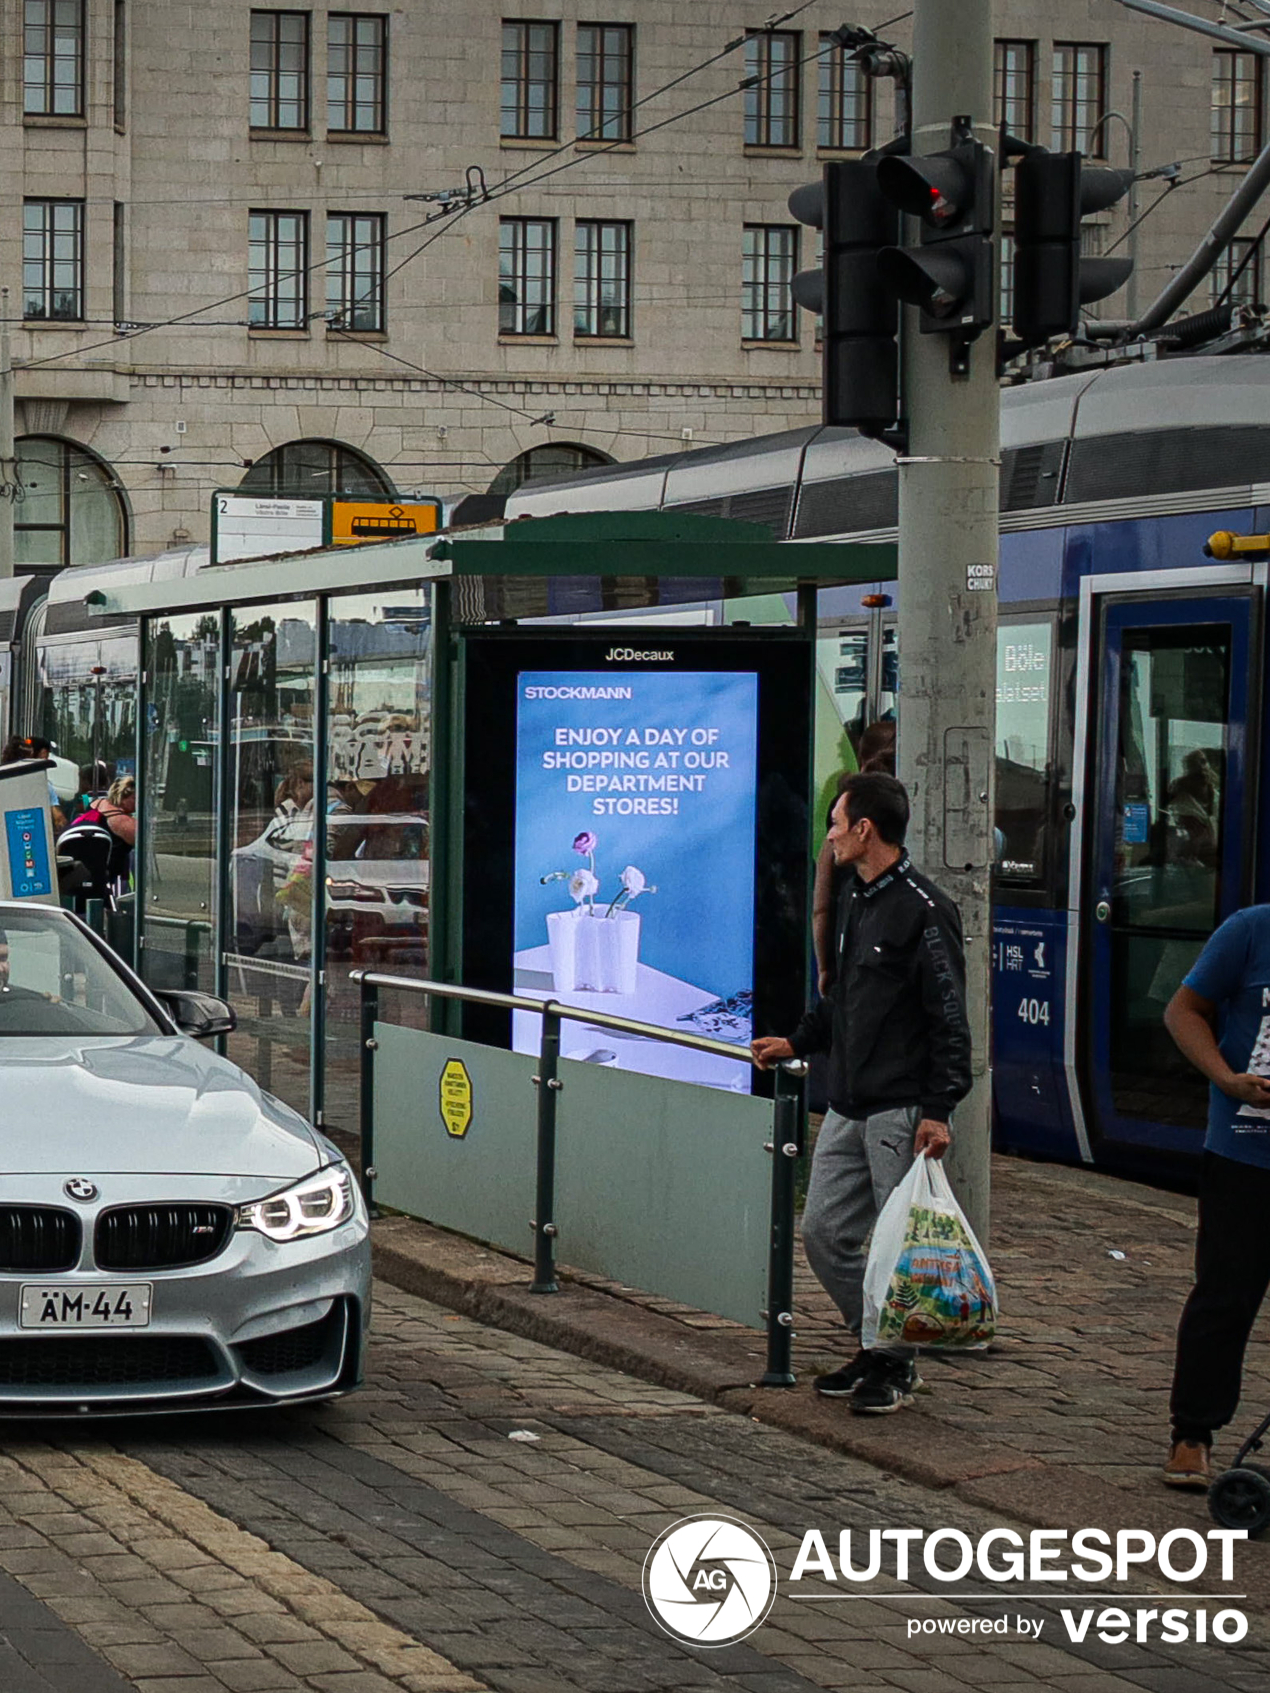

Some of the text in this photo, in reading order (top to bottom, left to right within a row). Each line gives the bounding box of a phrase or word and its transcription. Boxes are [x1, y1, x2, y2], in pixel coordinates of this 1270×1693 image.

[220, 500, 228, 513] 2
[605, 648, 674, 661] JCDecaux
[1005, 644, 1045, 672] Böle
[525, 686, 632, 699] STOCKMANN
[555, 728, 720, 746] ENJOY A DAY OF
[543, 751, 729, 769] SHOPPING AT OUR
[566, 775, 706, 792] DEPARTMENT
[593, 798, 679, 815] STORES!
[924, 925, 953, 984] BLACK
[1006, 945, 1024, 958] HSL
[1018, 998, 1050, 1026] 404
[40, 1290, 133, 1322] ÄM-44
